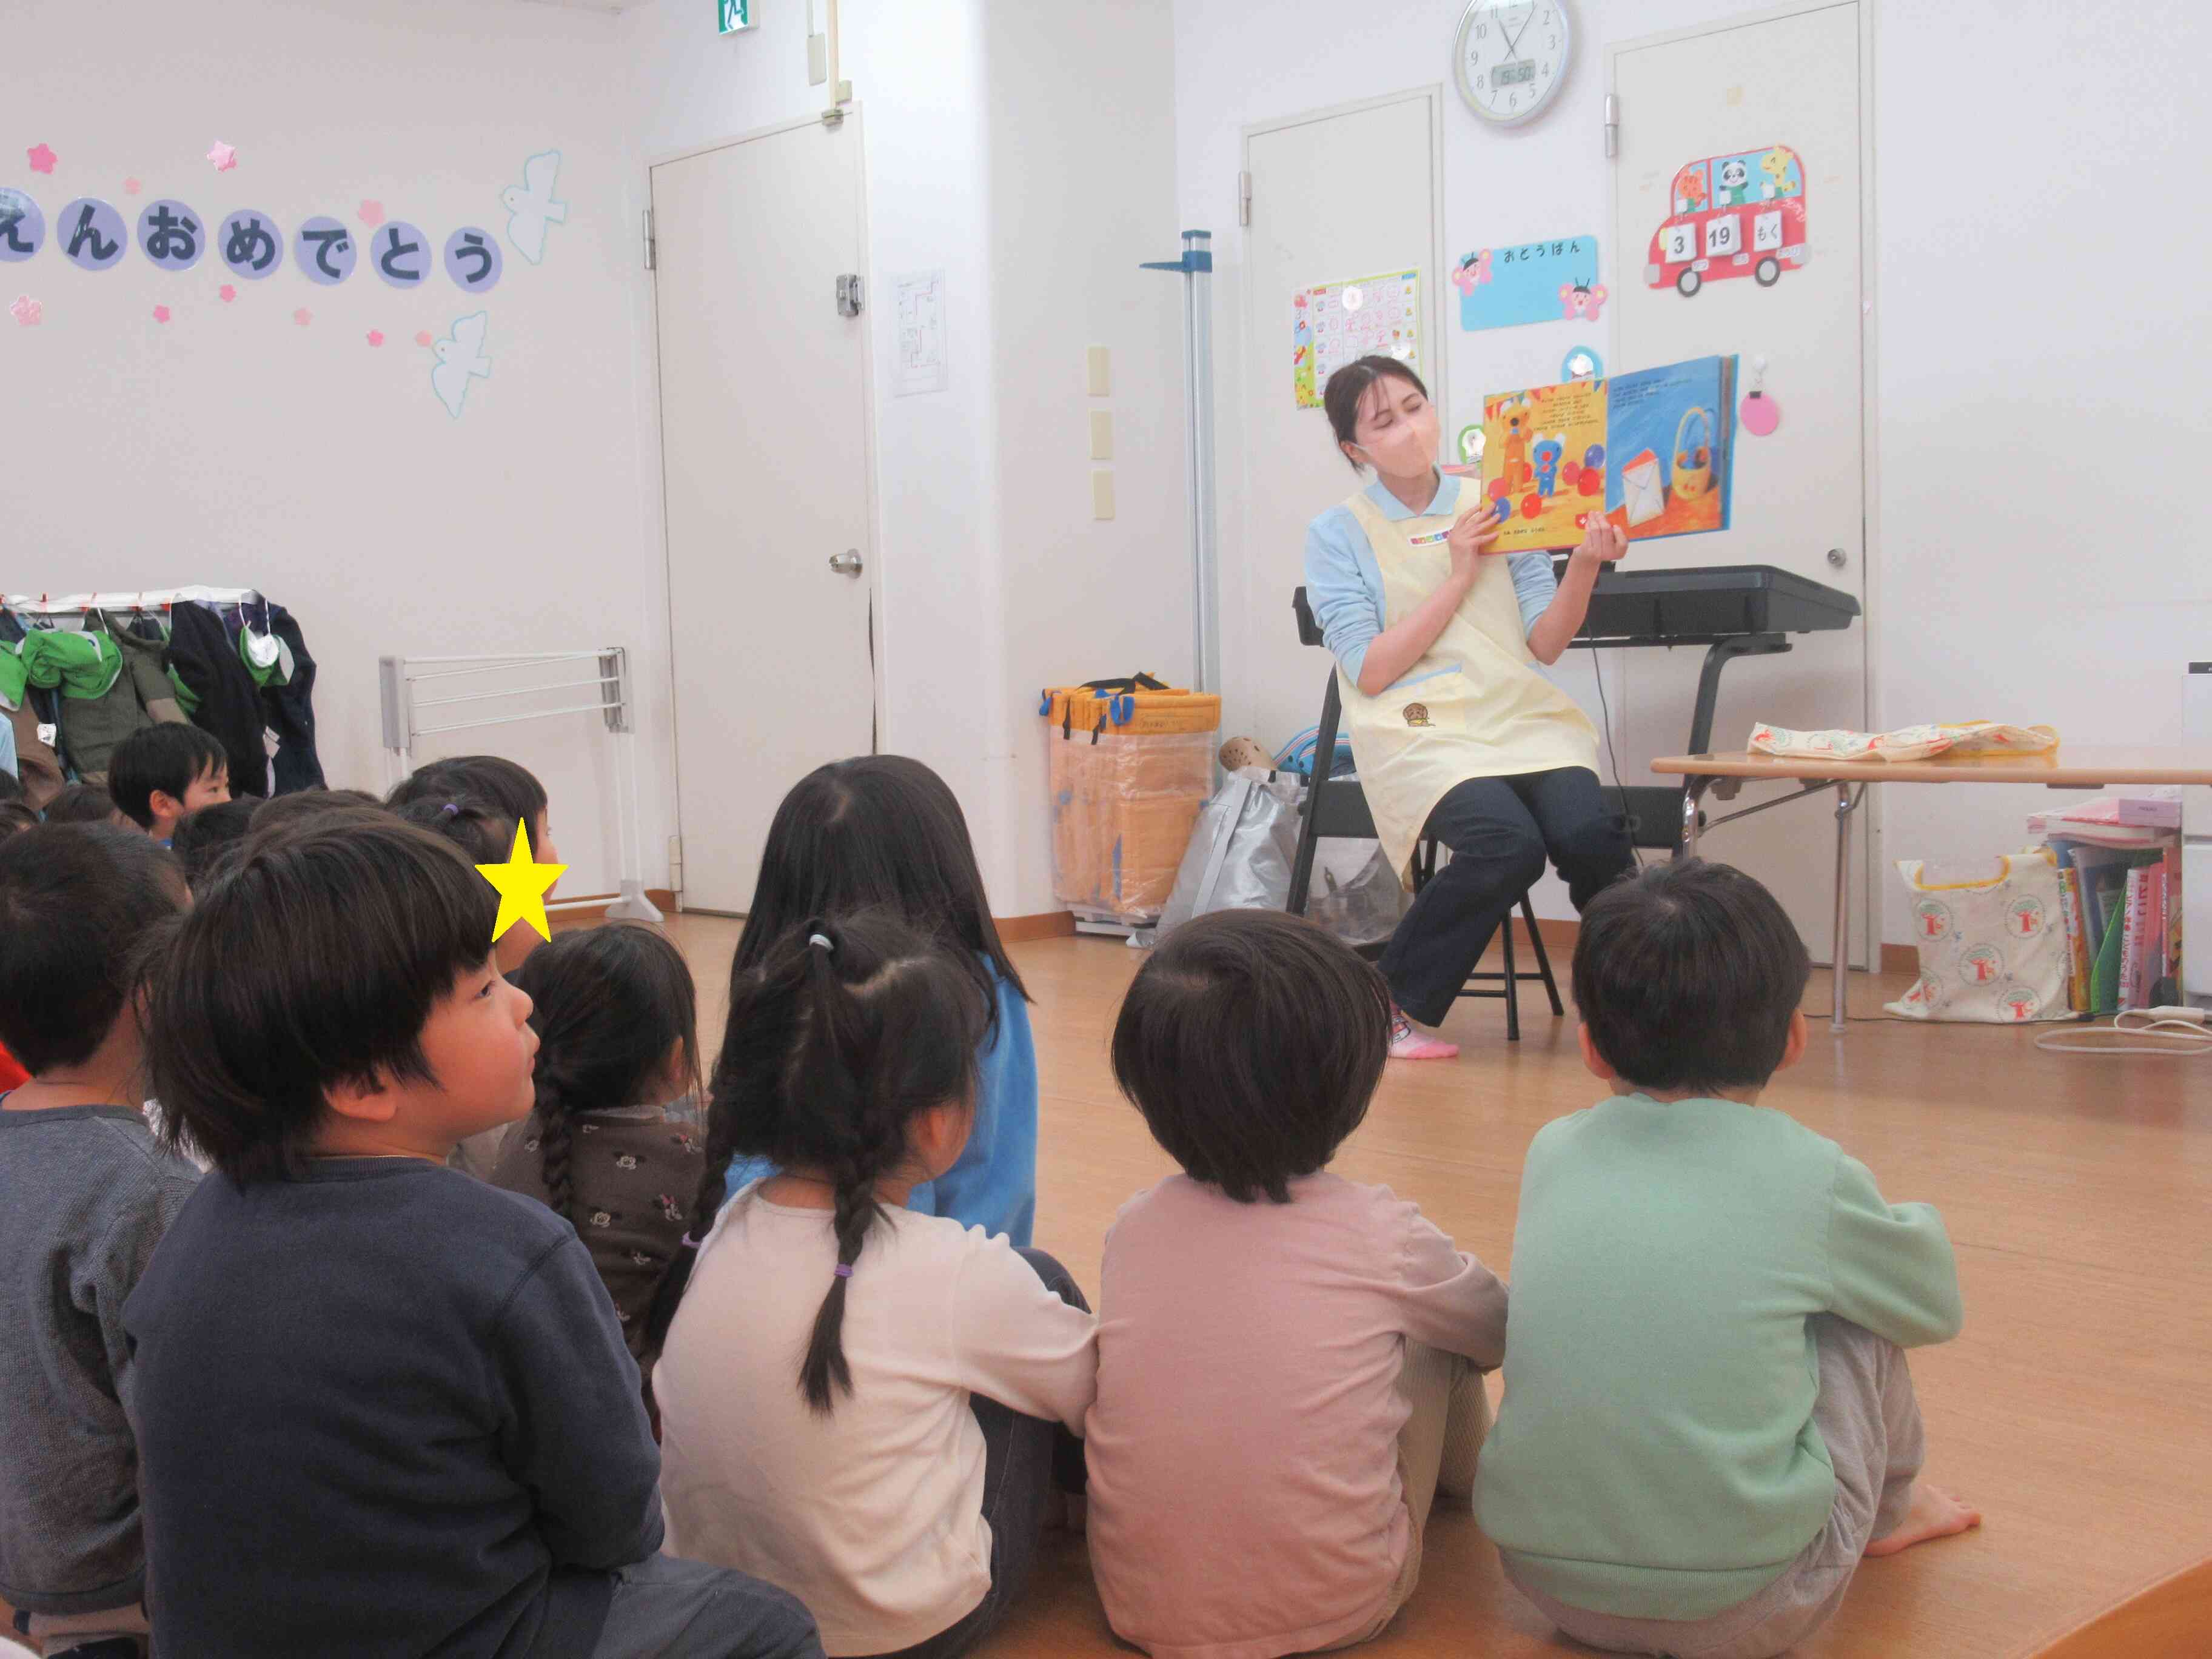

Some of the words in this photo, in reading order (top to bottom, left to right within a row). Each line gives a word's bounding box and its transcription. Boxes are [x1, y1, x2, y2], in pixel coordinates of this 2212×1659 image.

[1543, 10, 1550, 25] 2
[1475, 23, 1487, 39] 10
[1548, 35, 1556, 50] 3
[1470, 50, 1478, 66] 9
[1541, 61, 1549, 78] 4
[1477, 73, 1484, 89] 8
[1490, 89, 1499, 106] 7
[1529, 83, 1536, 98] 5
[1509, 92, 1517, 107] 6
[1674, 235, 1684, 254] 3
[1709, 227, 1731, 247] 19
[1757, 223, 1778, 241] もく
[1504, 240, 1581, 264] おとうばん
